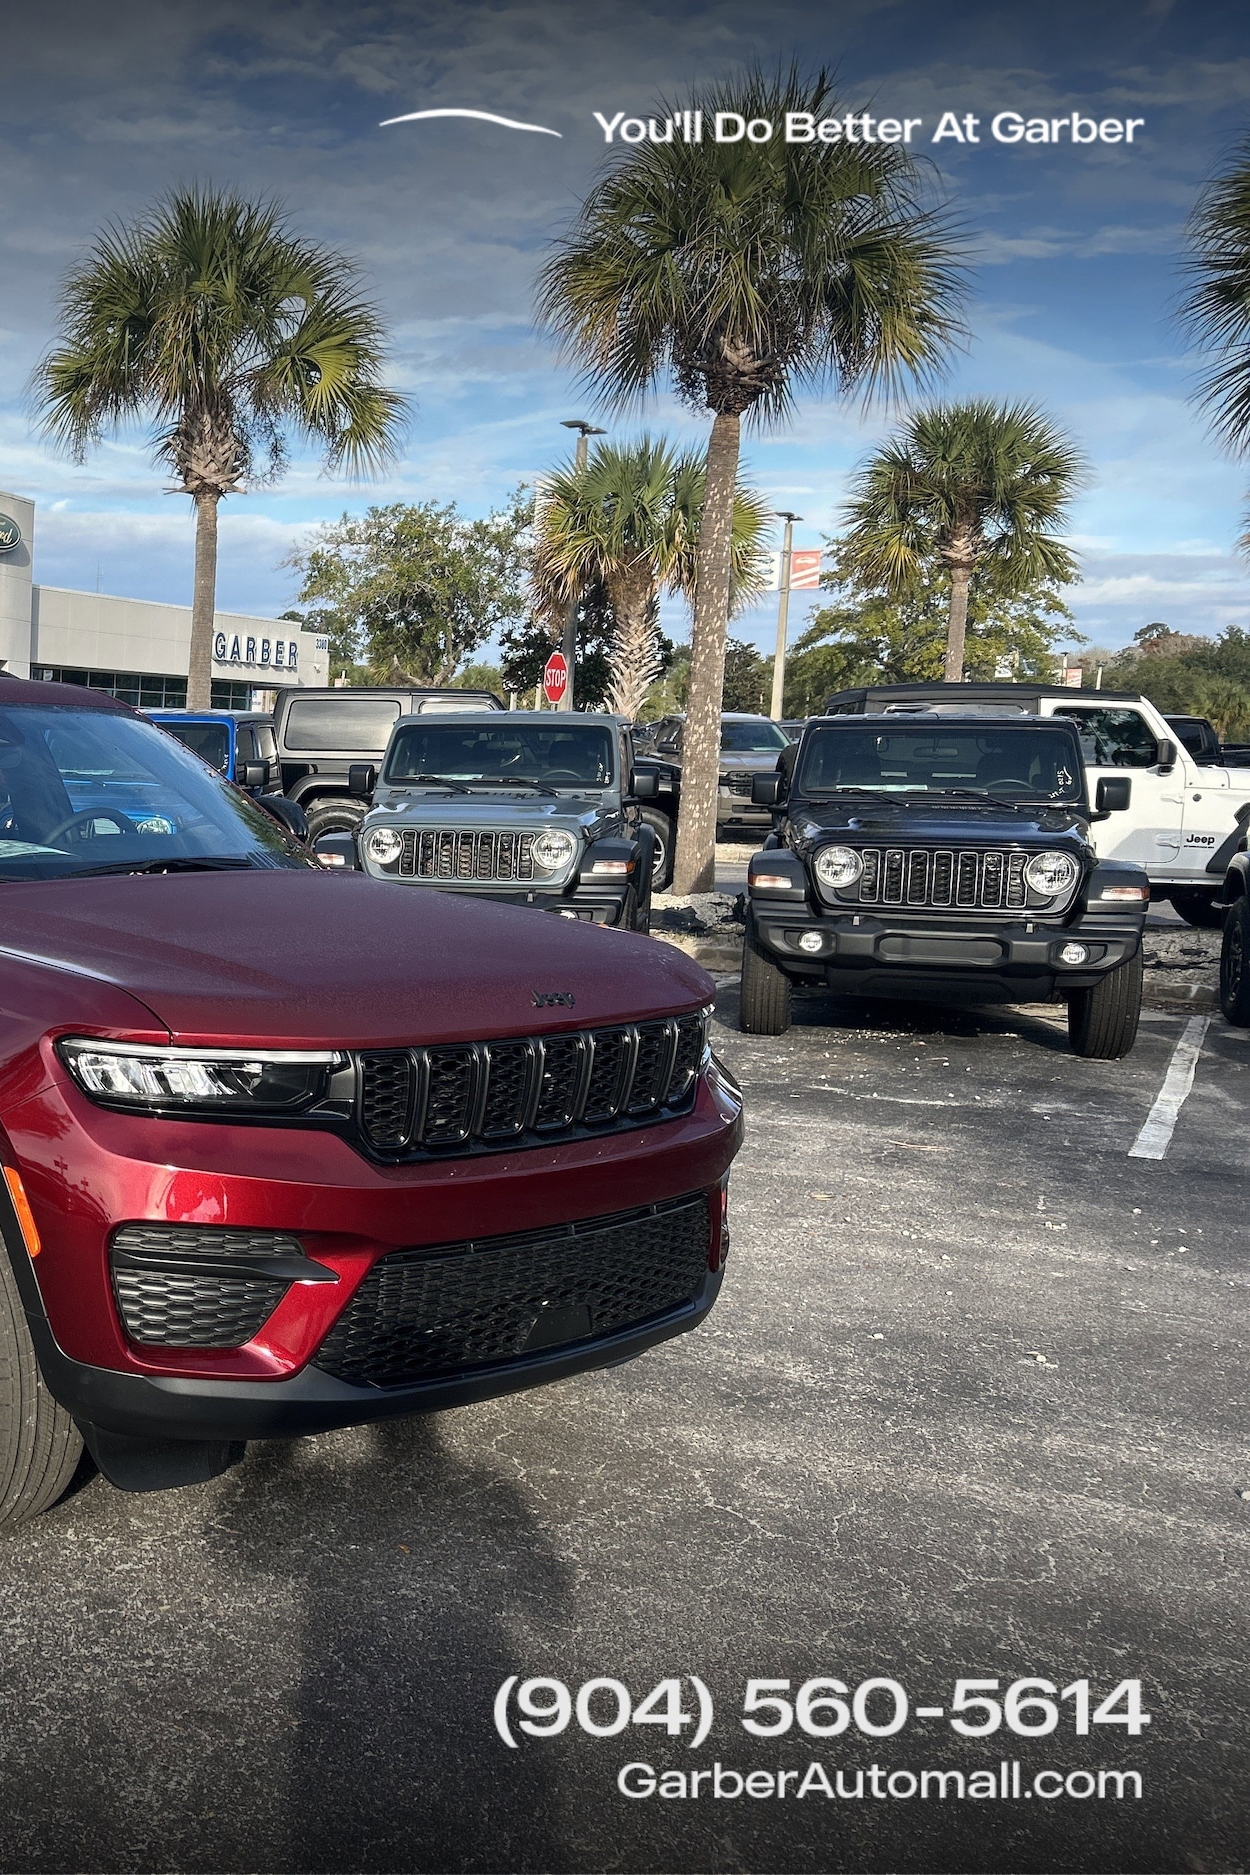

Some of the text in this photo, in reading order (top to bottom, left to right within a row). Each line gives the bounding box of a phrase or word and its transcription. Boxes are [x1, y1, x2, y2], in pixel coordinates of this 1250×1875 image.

[213, 631, 298, 667] GARBER
[546, 669, 566, 688] STOP
[1186, 833, 1215, 845] Jeep
[530, 989, 576, 1009] Jeep
